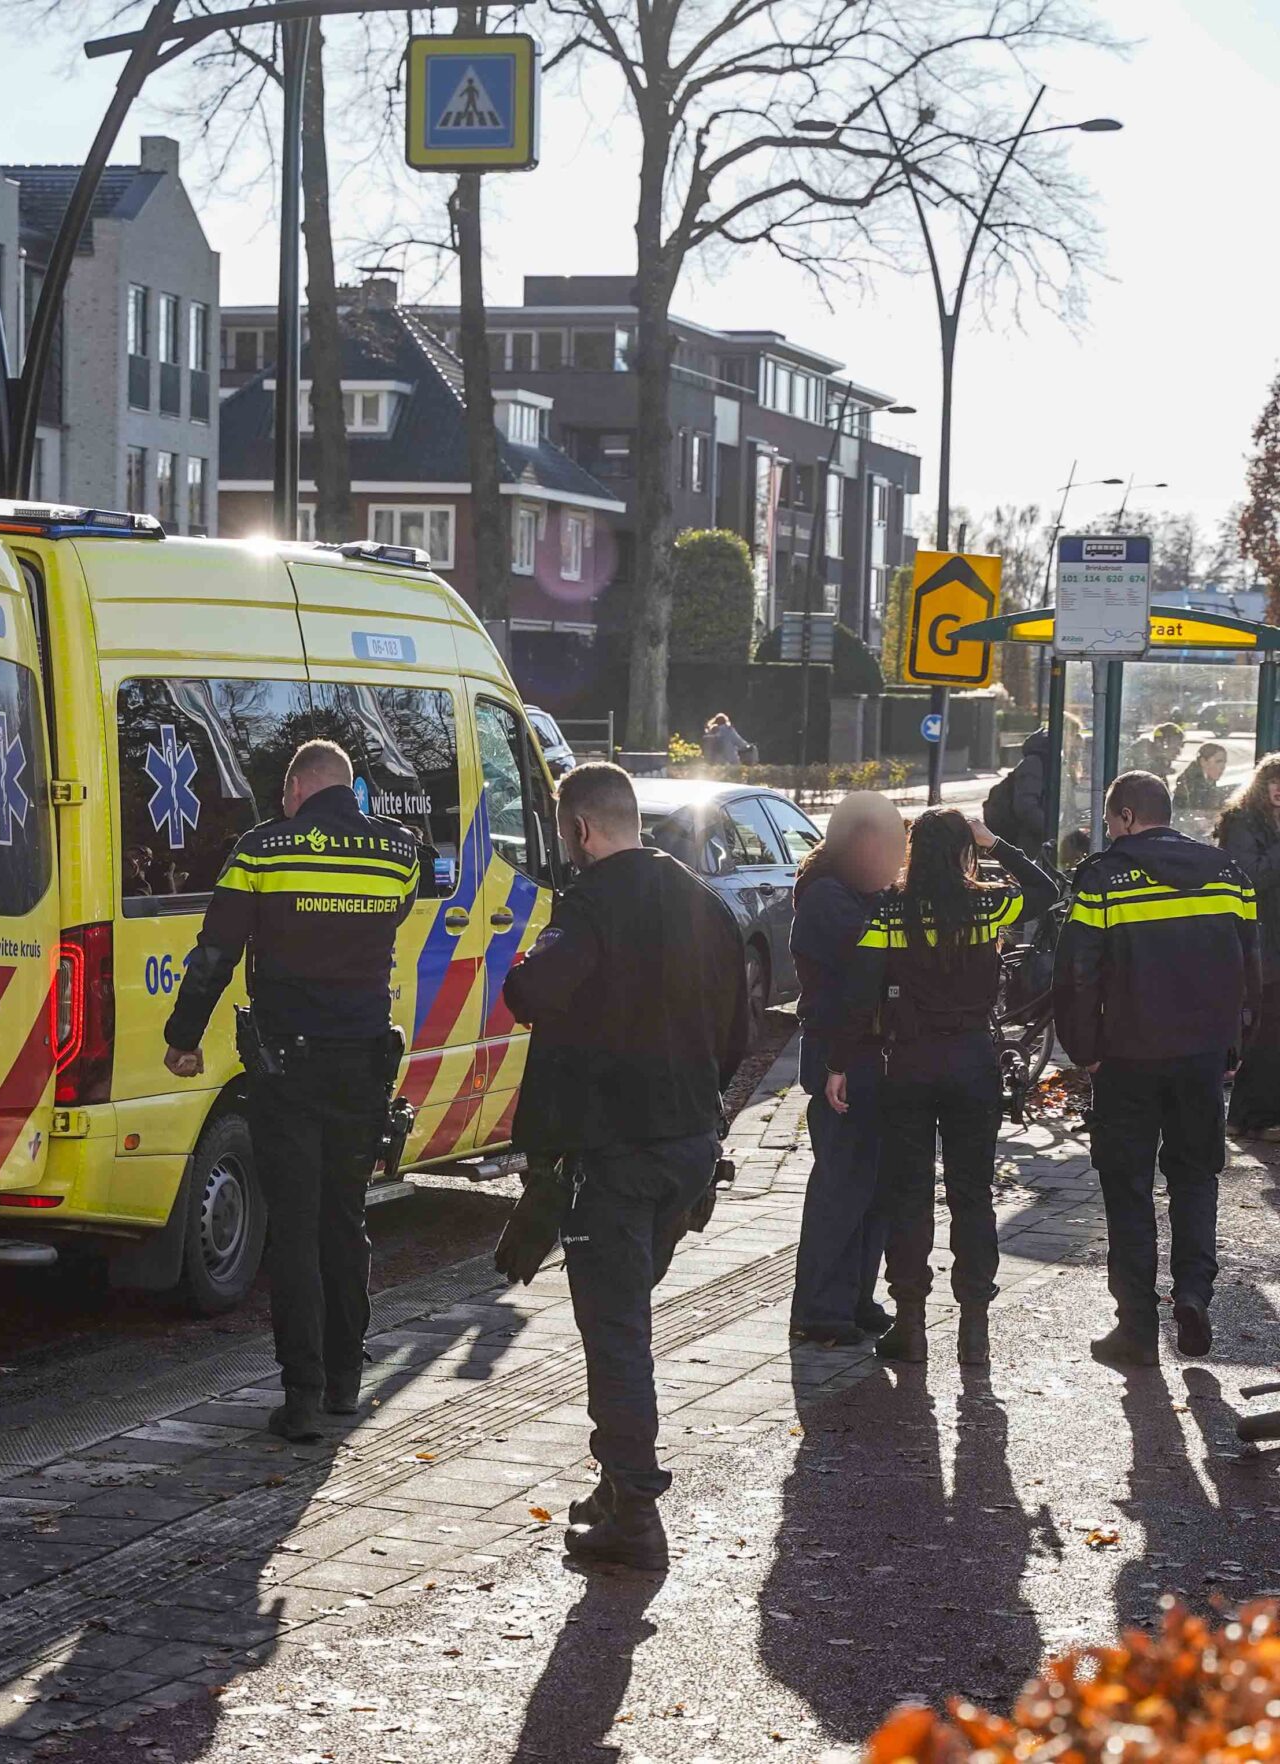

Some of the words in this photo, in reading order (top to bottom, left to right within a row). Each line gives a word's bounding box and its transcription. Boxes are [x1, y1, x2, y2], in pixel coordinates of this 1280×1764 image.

[1062, 575, 1078, 583] 101
[1084, 575, 1101, 583] 114
[929, 613, 961, 656] G
[1150, 623, 1183, 637] raat
[372, 638, 399, 656] 06-183
[371, 789, 402, 815] witte
[404, 789, 432, 815] kruis
[296, 897, 398, 914] HONDENGELEIDER
[20, 939, 41, 958] kruis
[145, 954, 192, 995] 06-
